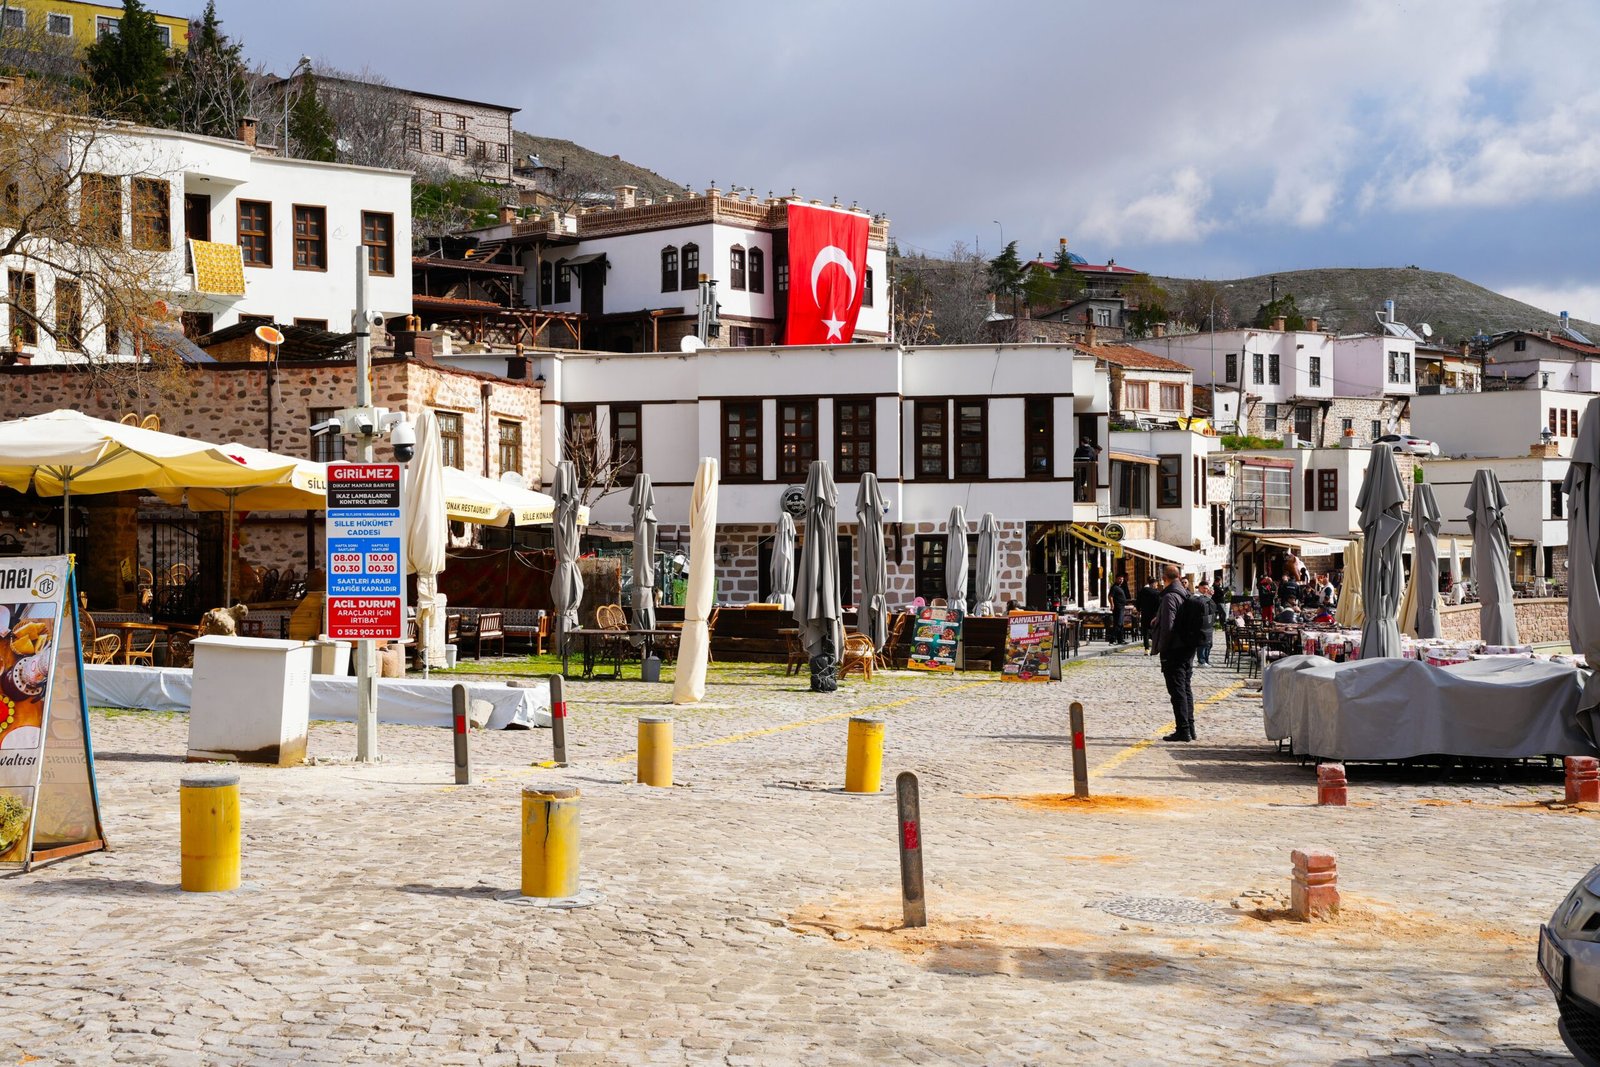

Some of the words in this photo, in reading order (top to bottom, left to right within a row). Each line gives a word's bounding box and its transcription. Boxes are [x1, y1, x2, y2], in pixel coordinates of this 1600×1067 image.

[307, 477, 326, 490] SİLL
[461, 503, 491, 514] RESTAURANT
[356, 519, 394, 527] HÜKÜMET
[333, 554, 360, 562] 08.00
[368, 554, 394, 562] 10.00
[358, 600, 396, 608] DURUM
[1009, 614, 1053, 624] KAHVALTILAR
